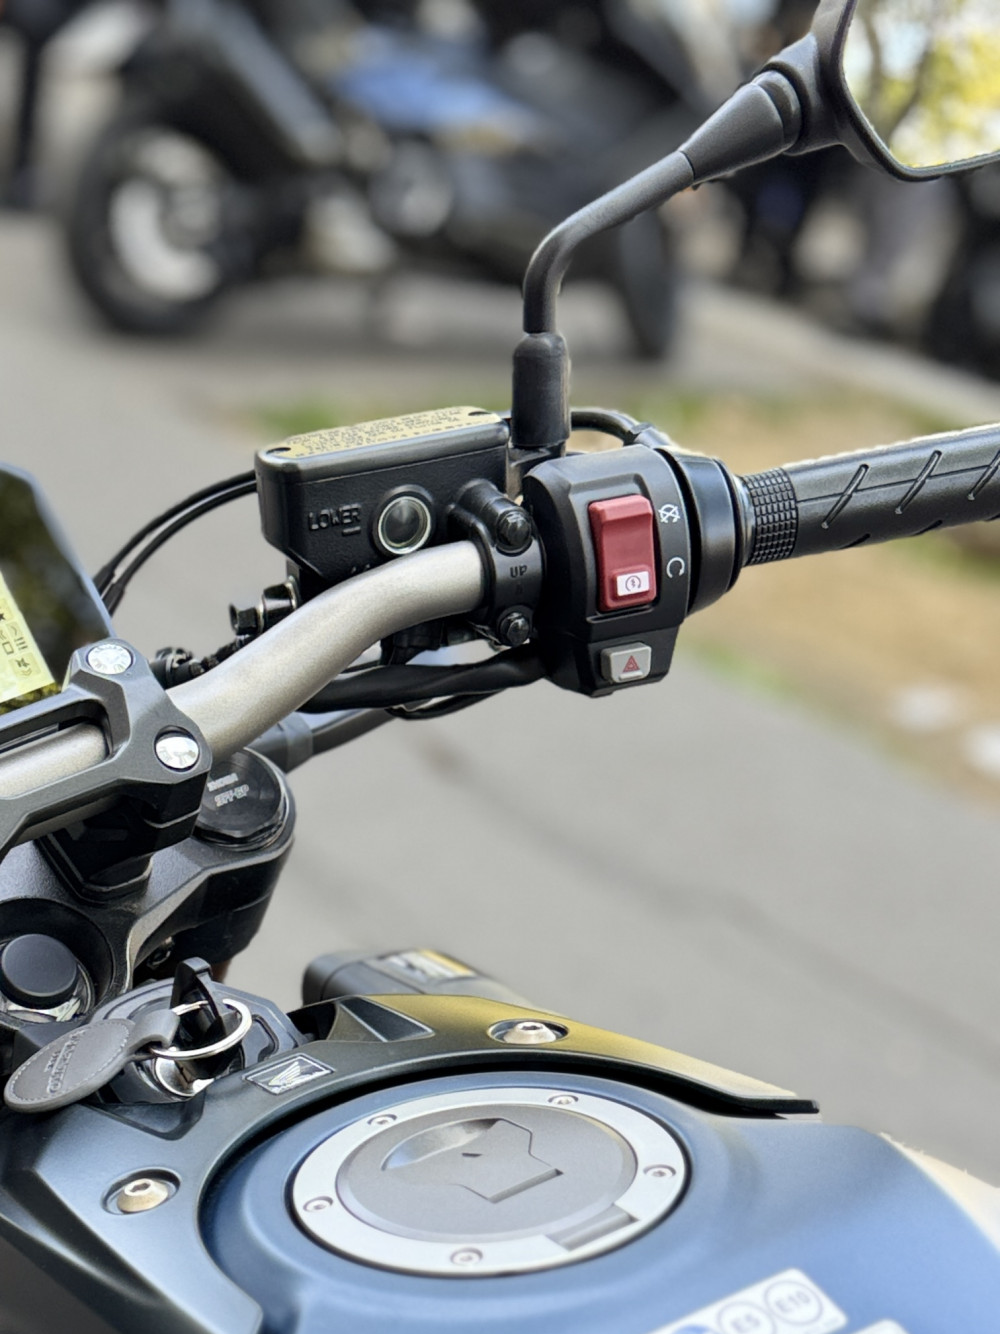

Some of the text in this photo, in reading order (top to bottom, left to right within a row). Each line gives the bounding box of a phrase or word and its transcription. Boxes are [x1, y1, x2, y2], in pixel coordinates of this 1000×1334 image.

[510, 564, 528, 578] UP
[730, 1290, 811, 1334] E5 E10
